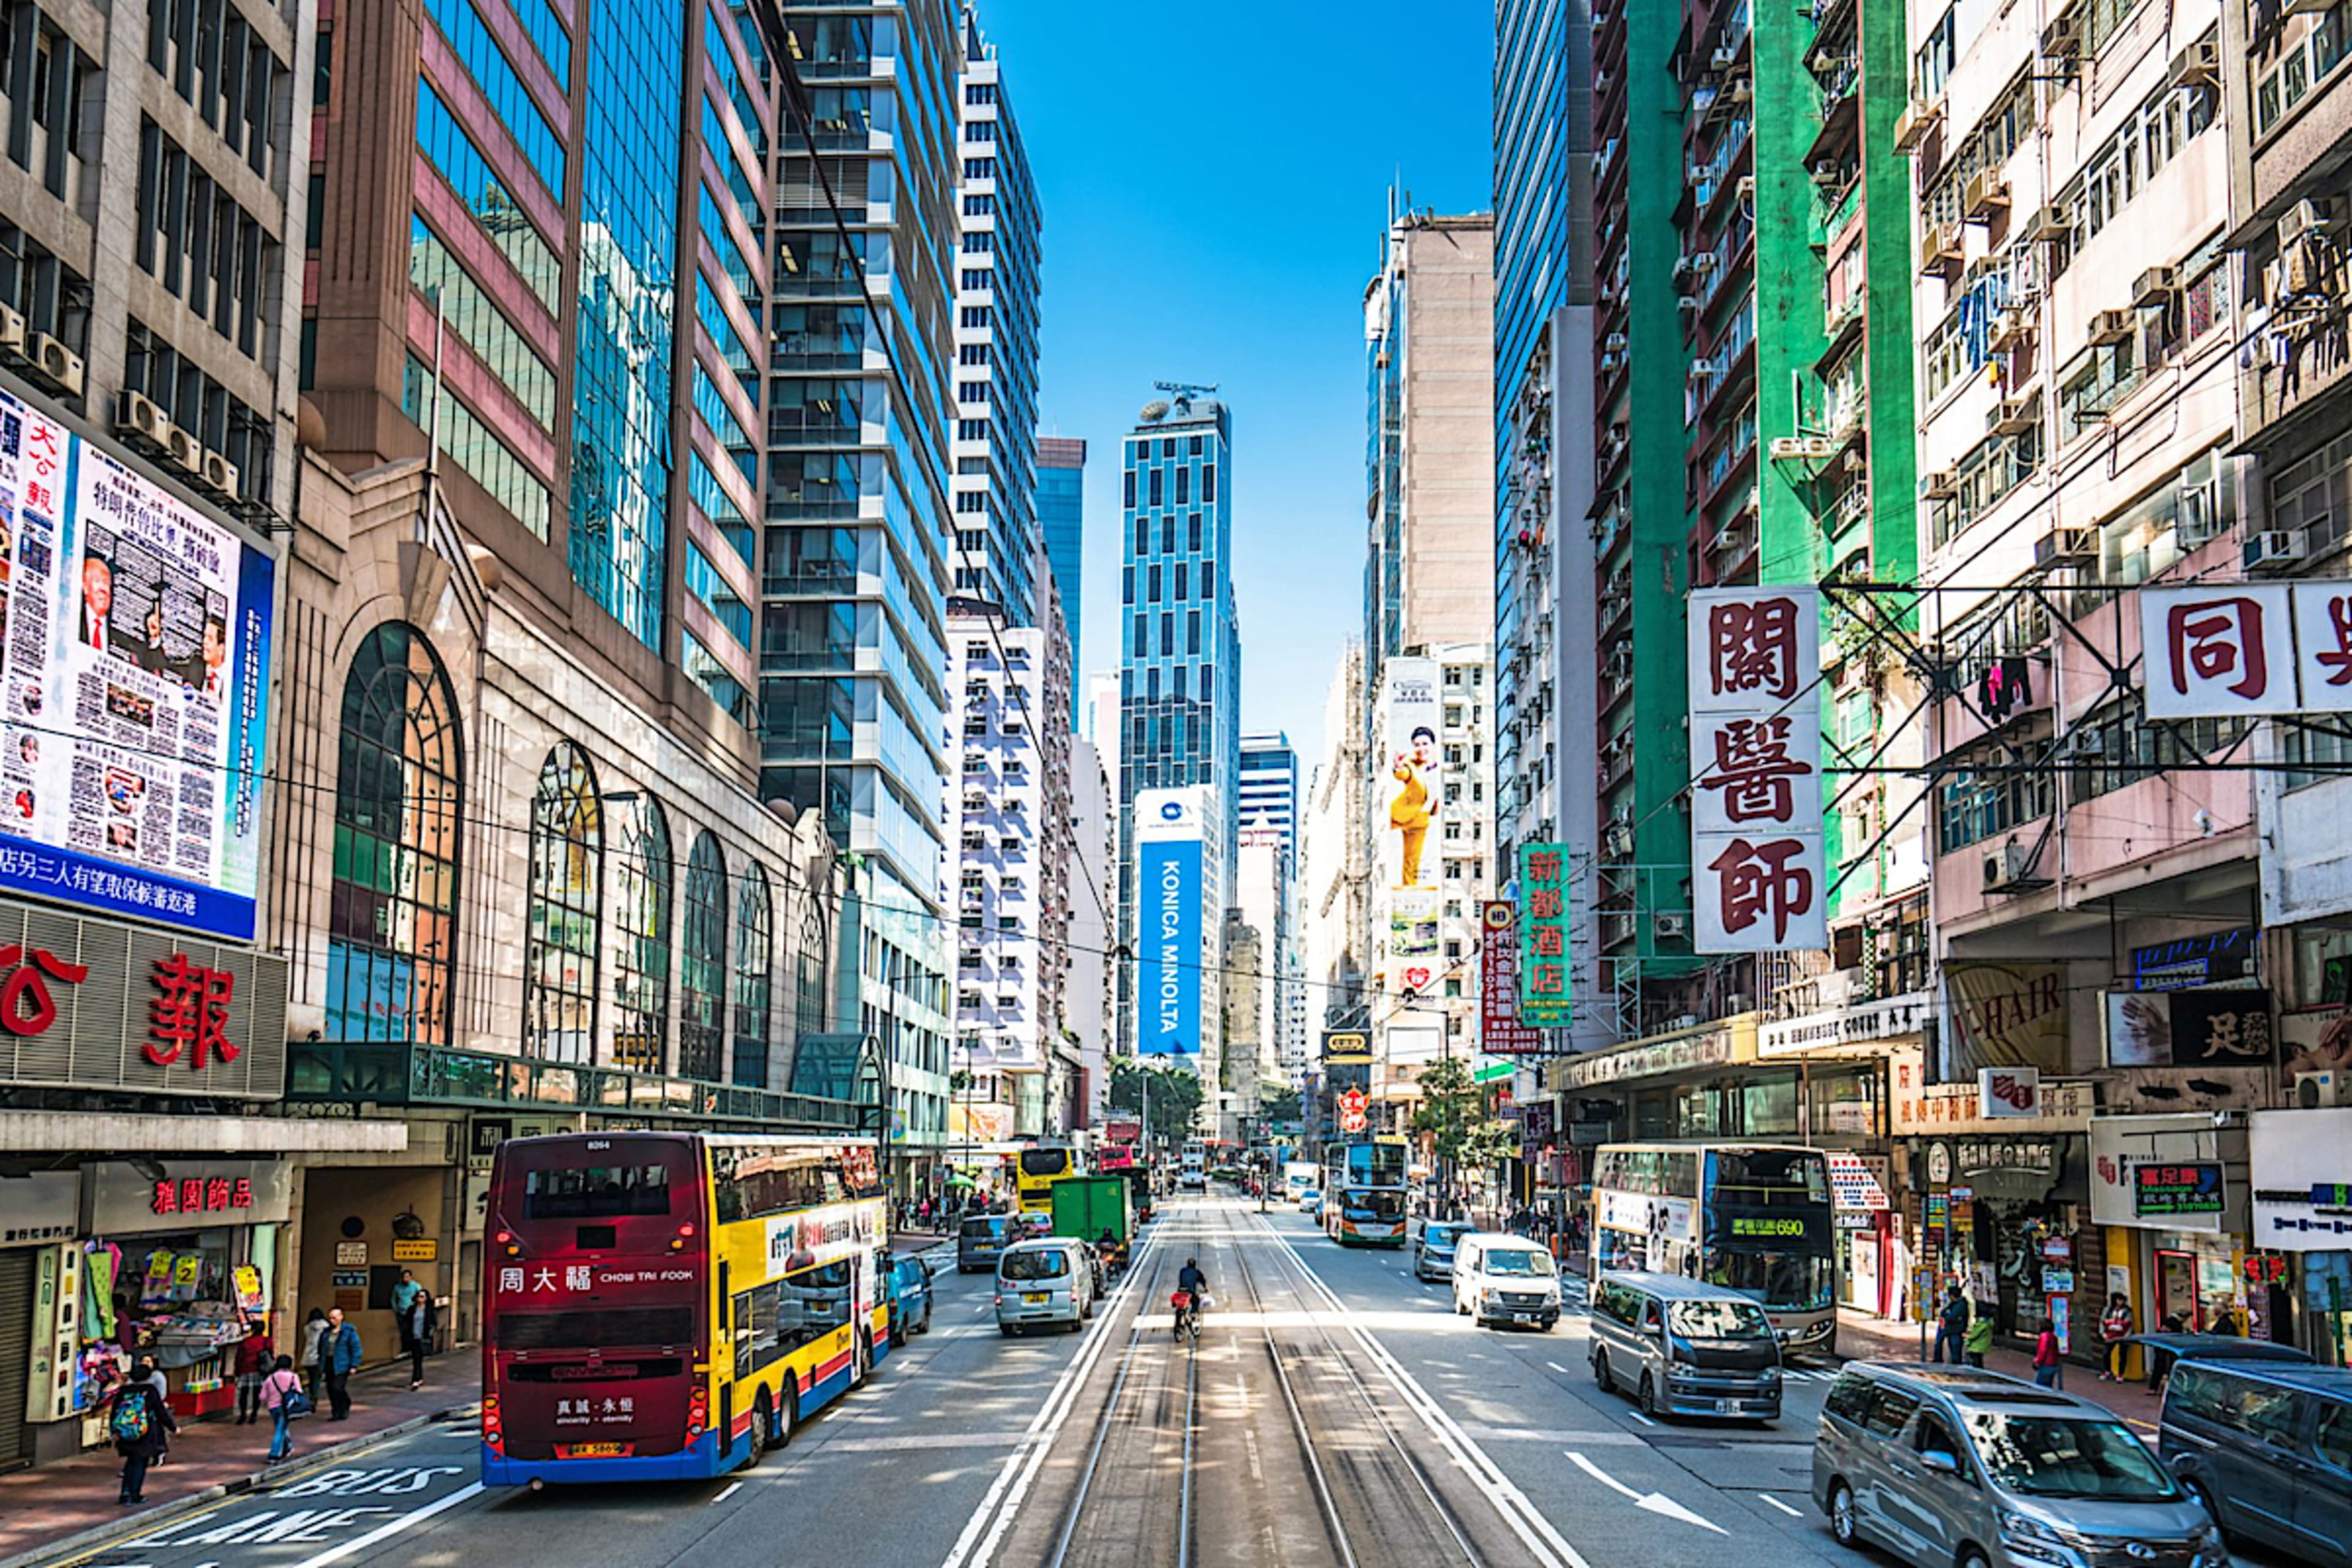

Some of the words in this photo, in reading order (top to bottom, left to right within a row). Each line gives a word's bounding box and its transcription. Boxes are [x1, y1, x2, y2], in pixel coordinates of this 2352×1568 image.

[1699, 597, 1813, 944] 關醫師
[1161, 861, 1180, 939] KONICA
[1529, 851, 1562, 993] 新都酒店
[1160, 945, 1179, 1033] MINOLTA
[152, 1178, 252, 1215] 雅園飾品
[1777, 1218, 1804, 1236] 690
[499, 1265, 591, 1294] 周大福
[600, 1273, 635, 1283] CHOW
[637, 1271, 657, 1281] TAI
[660, 1270, 693, 1280] FOOK
[270, 1468, 464, 1498] BUS
[118, 1506, 393, 1548] LANE
